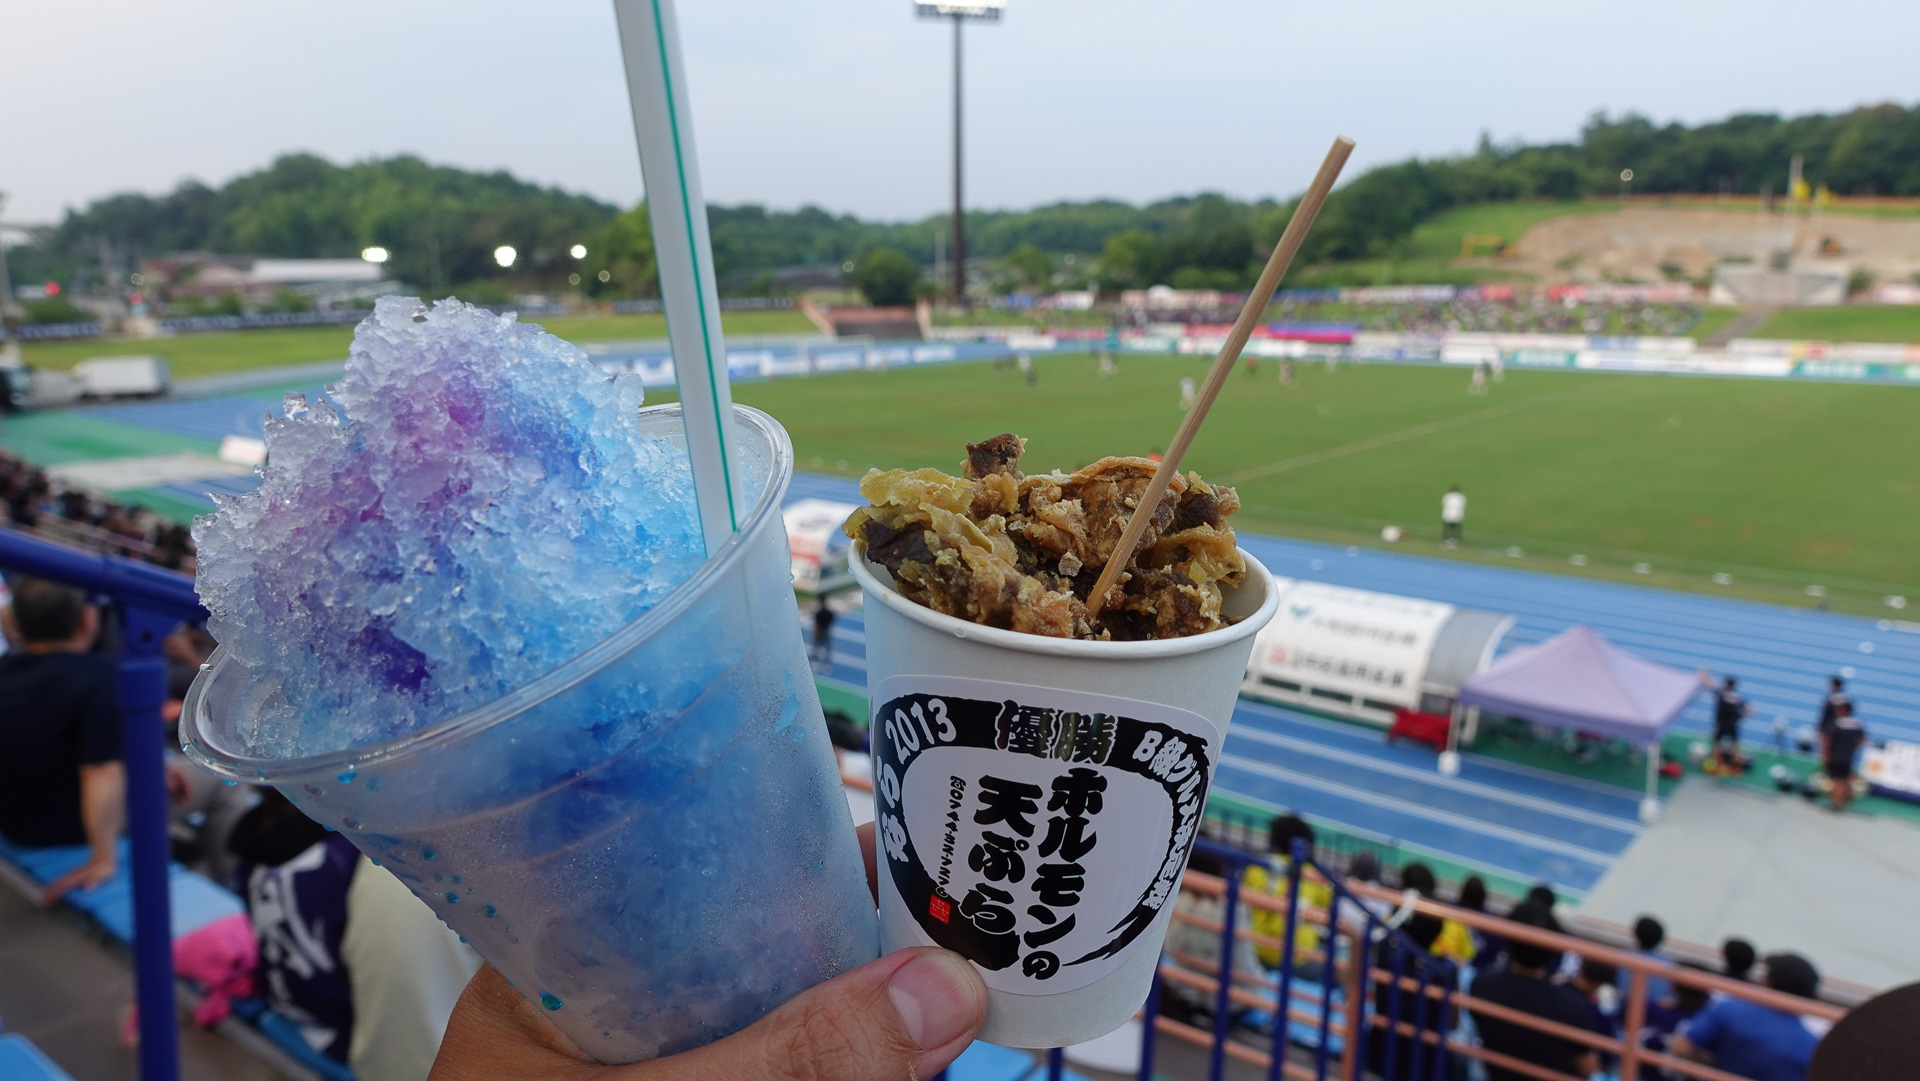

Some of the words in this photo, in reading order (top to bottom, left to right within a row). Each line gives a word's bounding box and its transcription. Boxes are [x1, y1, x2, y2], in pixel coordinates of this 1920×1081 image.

[885, 698, 957, 765] 2013
[995, 699, 1119, 764] 優勝
[958, 774, 1043, 935] 天ぷら
[1022, 768, 1107, 980] ホルモンの
